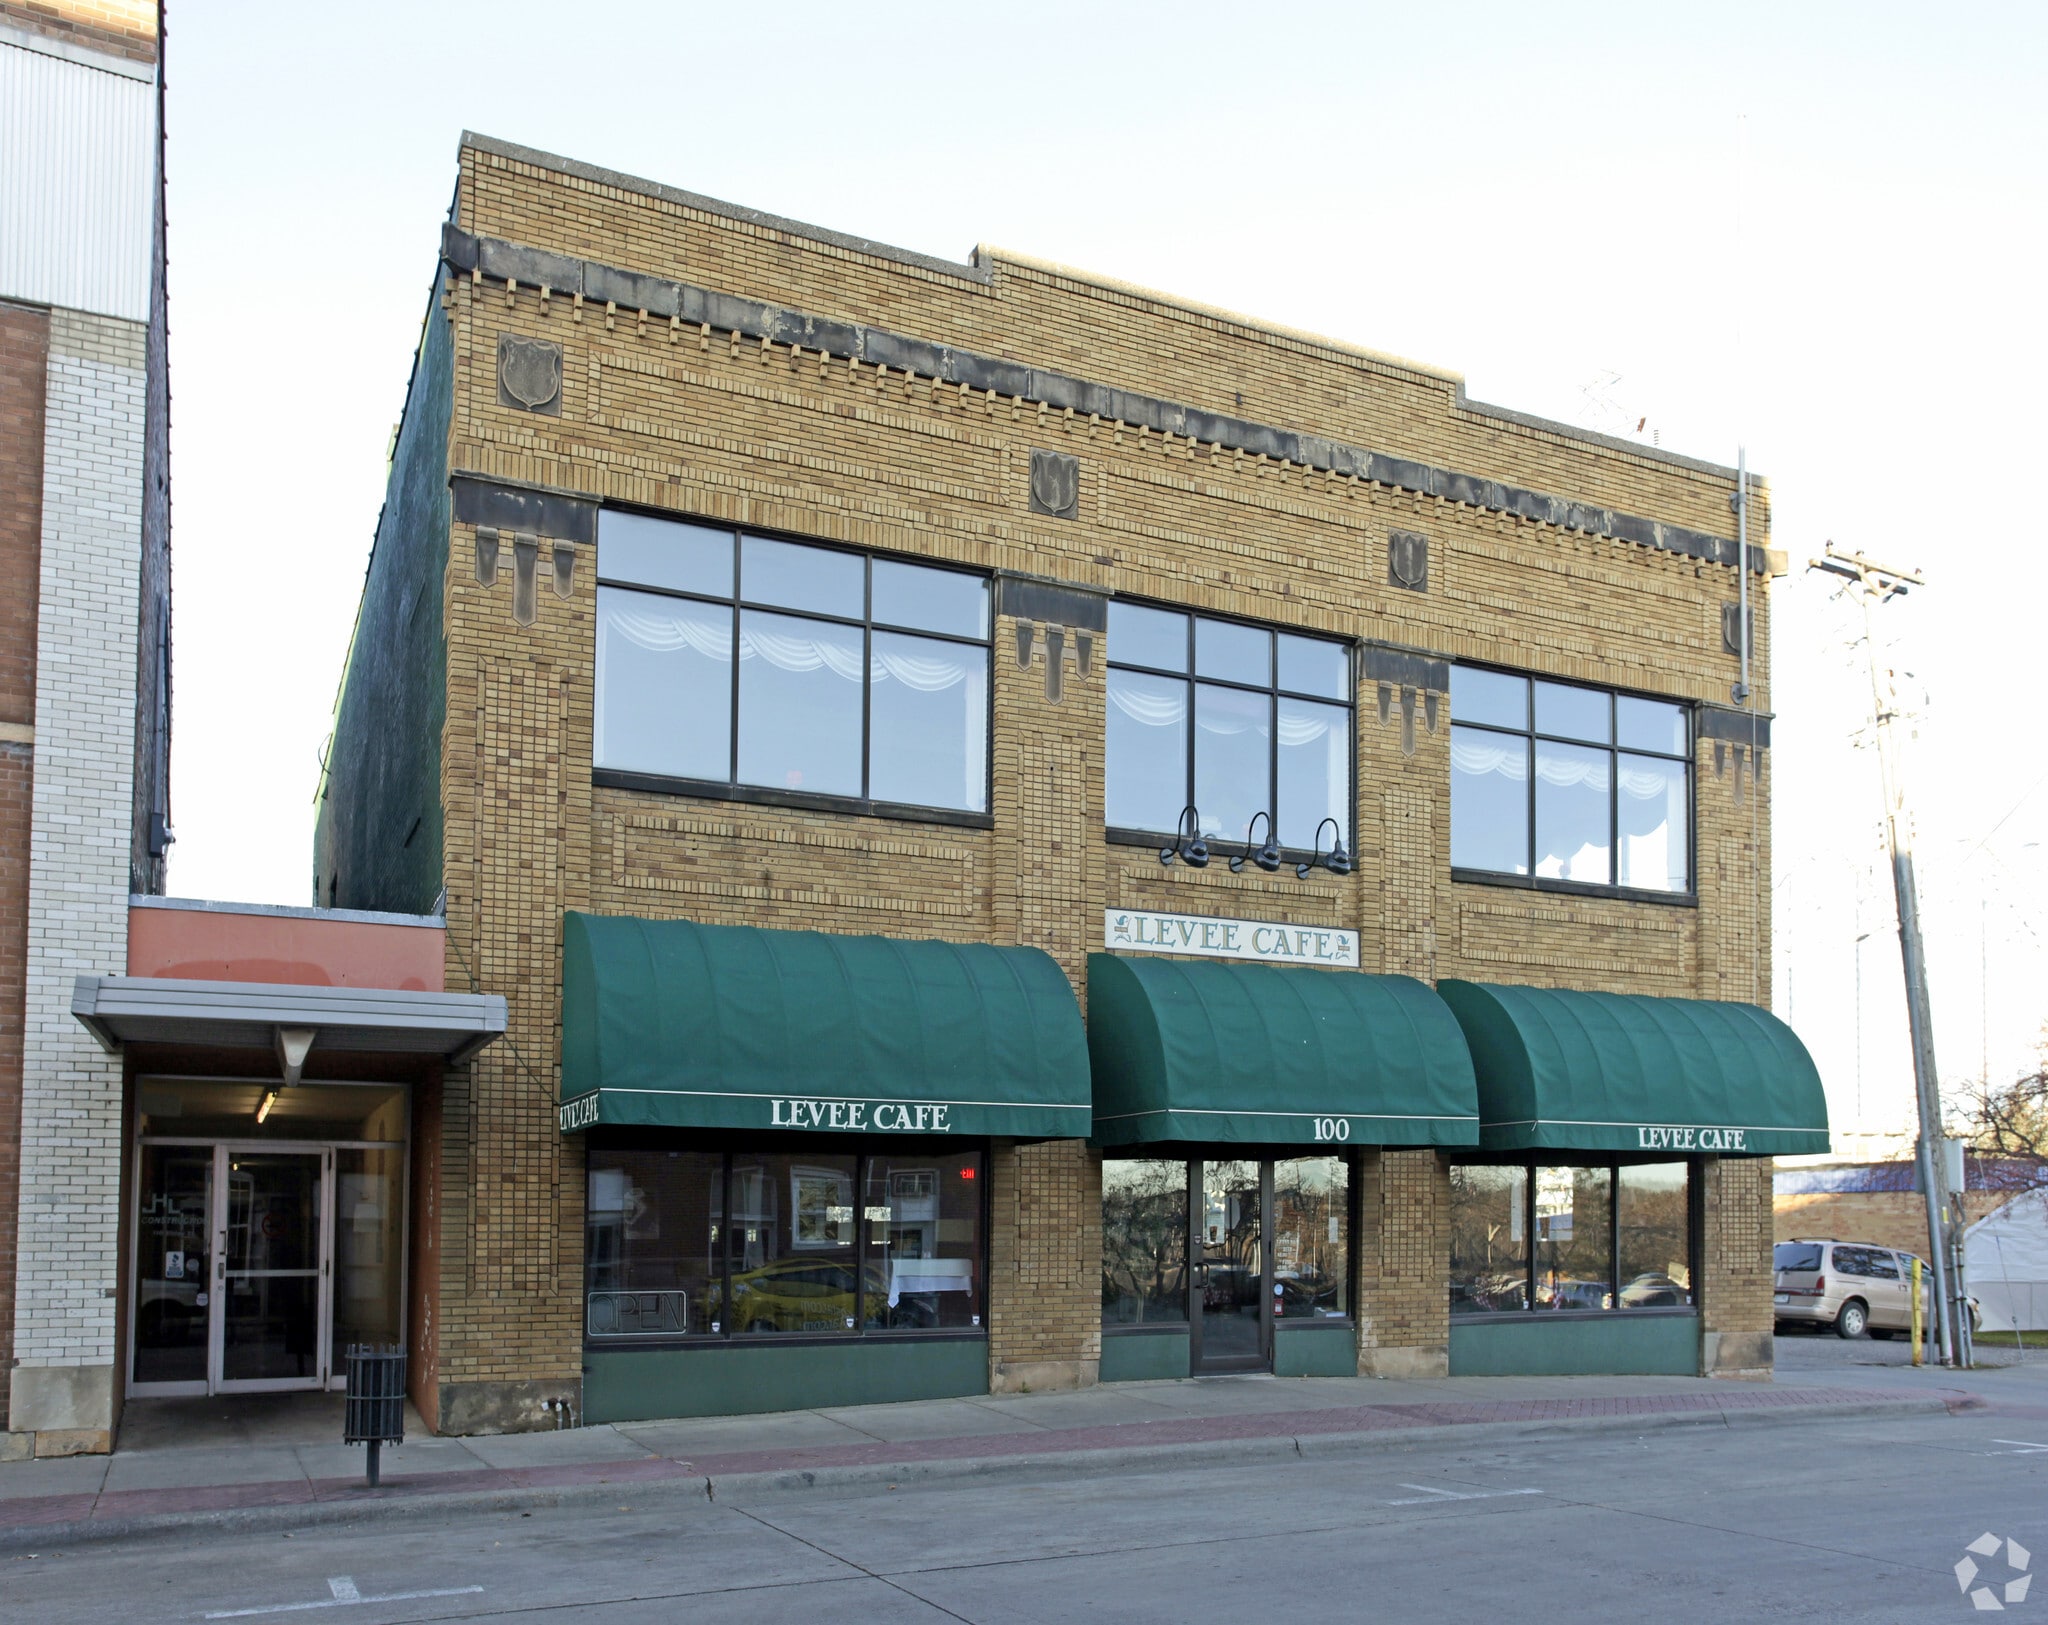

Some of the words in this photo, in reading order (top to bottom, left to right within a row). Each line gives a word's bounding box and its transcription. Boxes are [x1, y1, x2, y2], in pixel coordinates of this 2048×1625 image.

[1134, 916, 1242, 952] LEVEE
[1252, 927, 1333, 961] CAFE
[580, 1093, 599, 1124] CAFE
[771, 1100, 868, 1130] LEVEE
[873, 1104, 951, 1132] CAFE
[1313, 1117, 1350, 1141] 100
[1638, 1127, 1697, 1150] LEVEE
[1698, 1129, 1747, 1151] CAFE
[593, 1294, 682, 1332] OPEN
